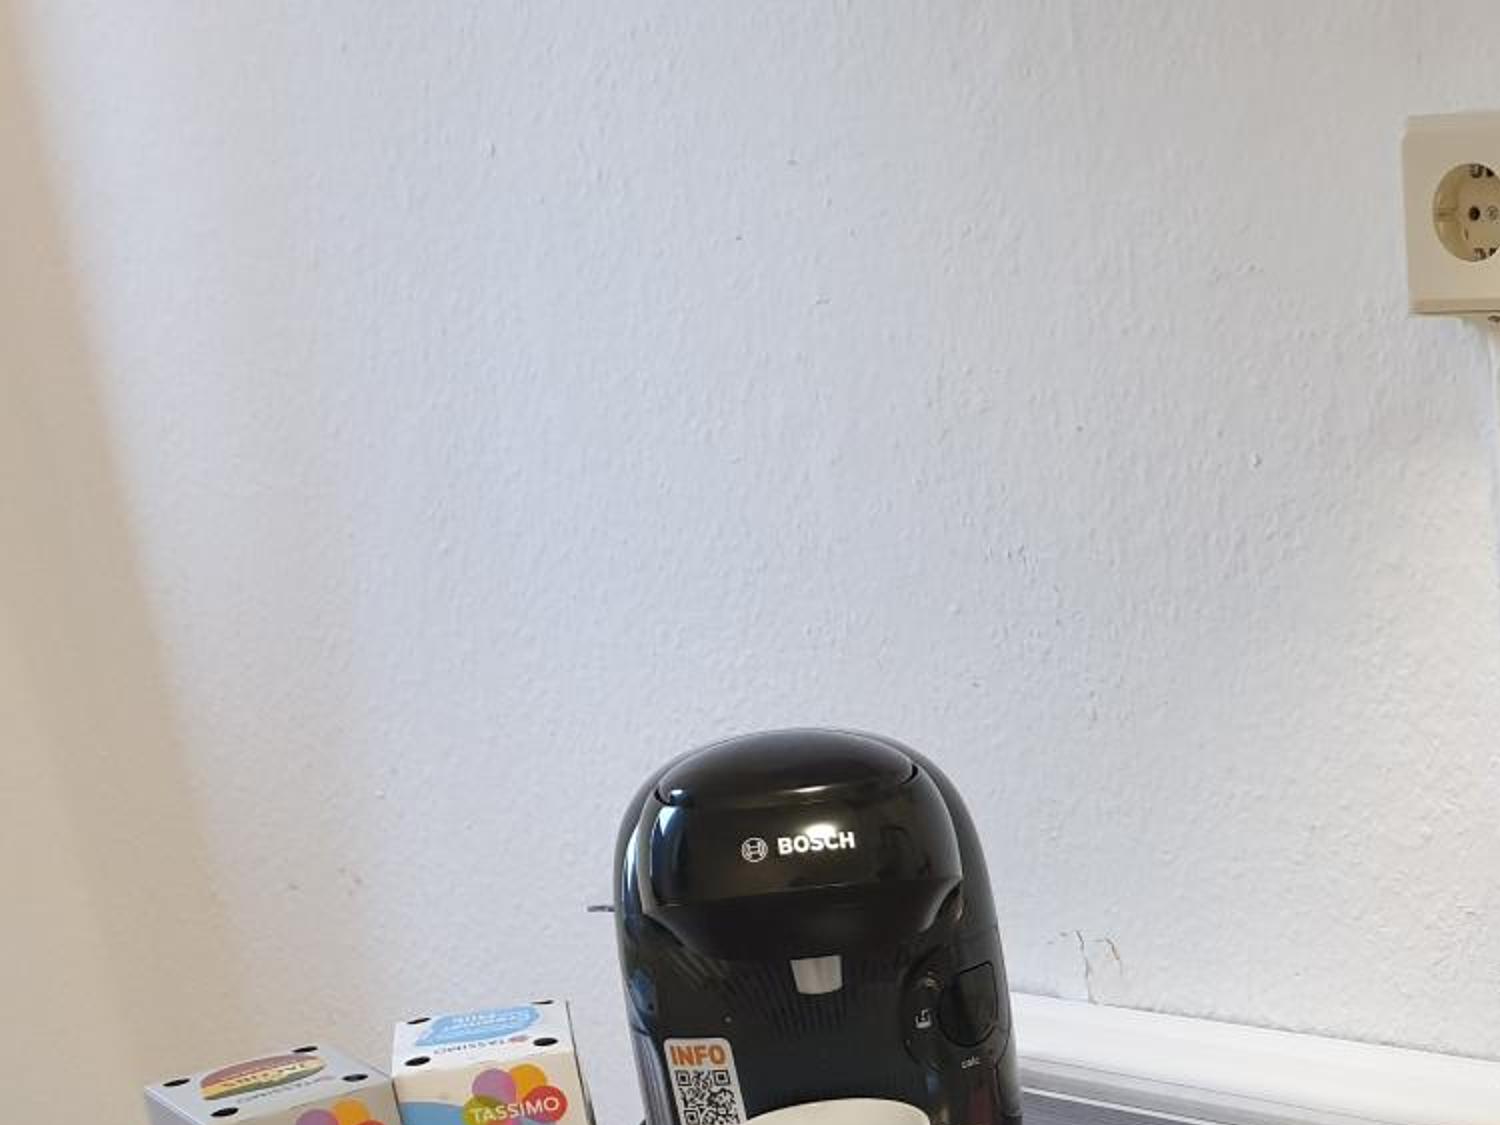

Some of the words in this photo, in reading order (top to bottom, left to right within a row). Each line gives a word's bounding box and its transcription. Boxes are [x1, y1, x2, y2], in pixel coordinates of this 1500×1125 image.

[777, 831, 856, 856] BOSCH
[670, 1045, 726, 1066] INFO
[473, 1097, 560, 1122] TASSIMO
